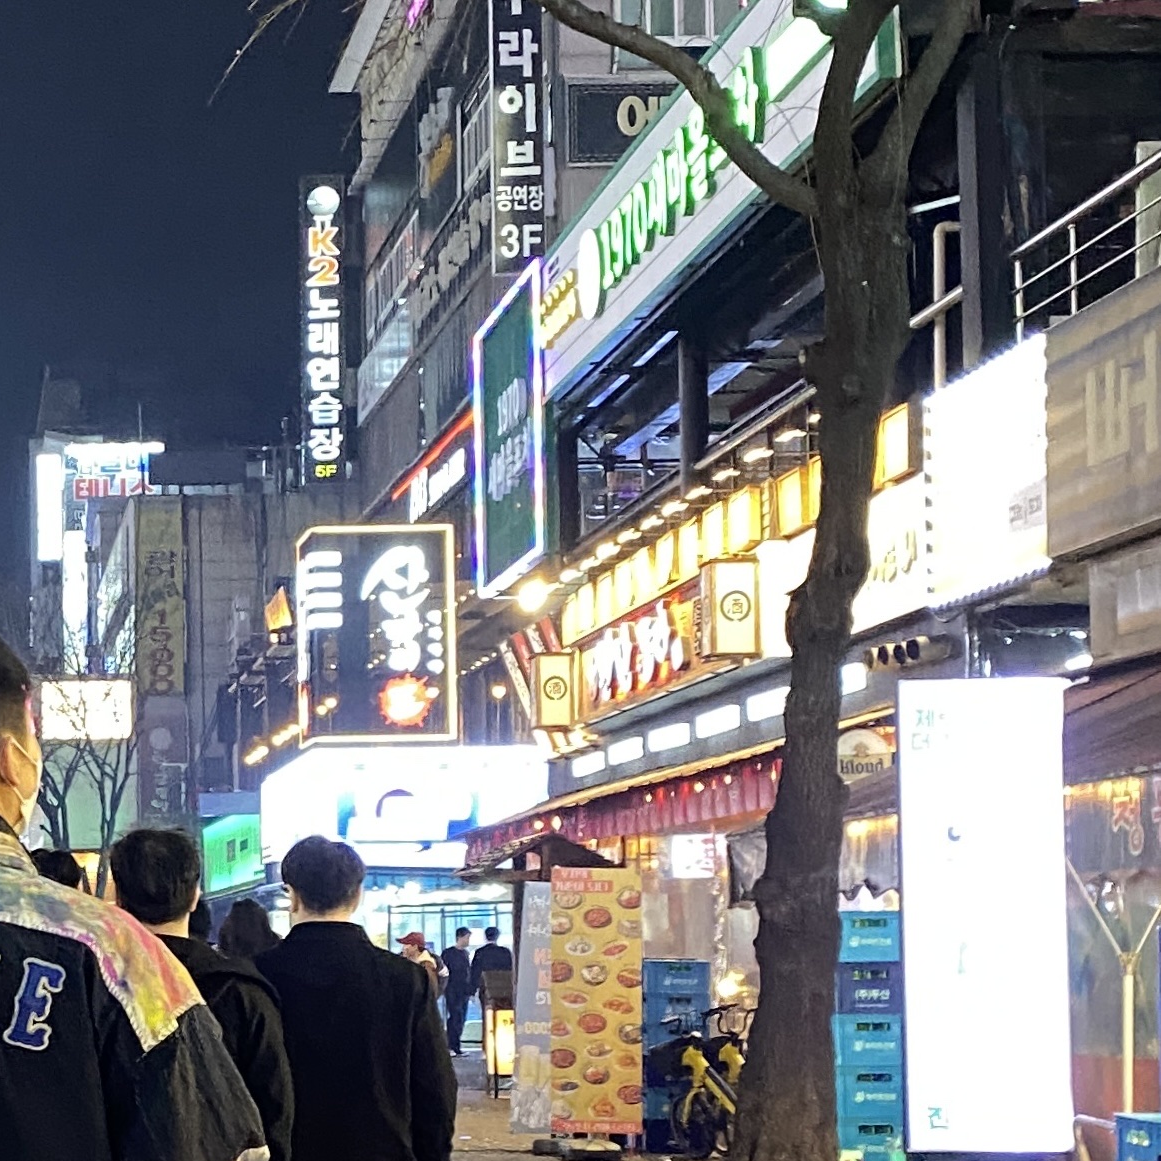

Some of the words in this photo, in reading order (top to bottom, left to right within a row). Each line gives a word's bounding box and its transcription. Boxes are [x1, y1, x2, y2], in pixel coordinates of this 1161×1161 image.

[495, 185, 544, 212] 공연장
[500, 224, 543, 258] 3F
[314, 464, 337, 478] 5F
[73, 477, 156, 501] 테니스
